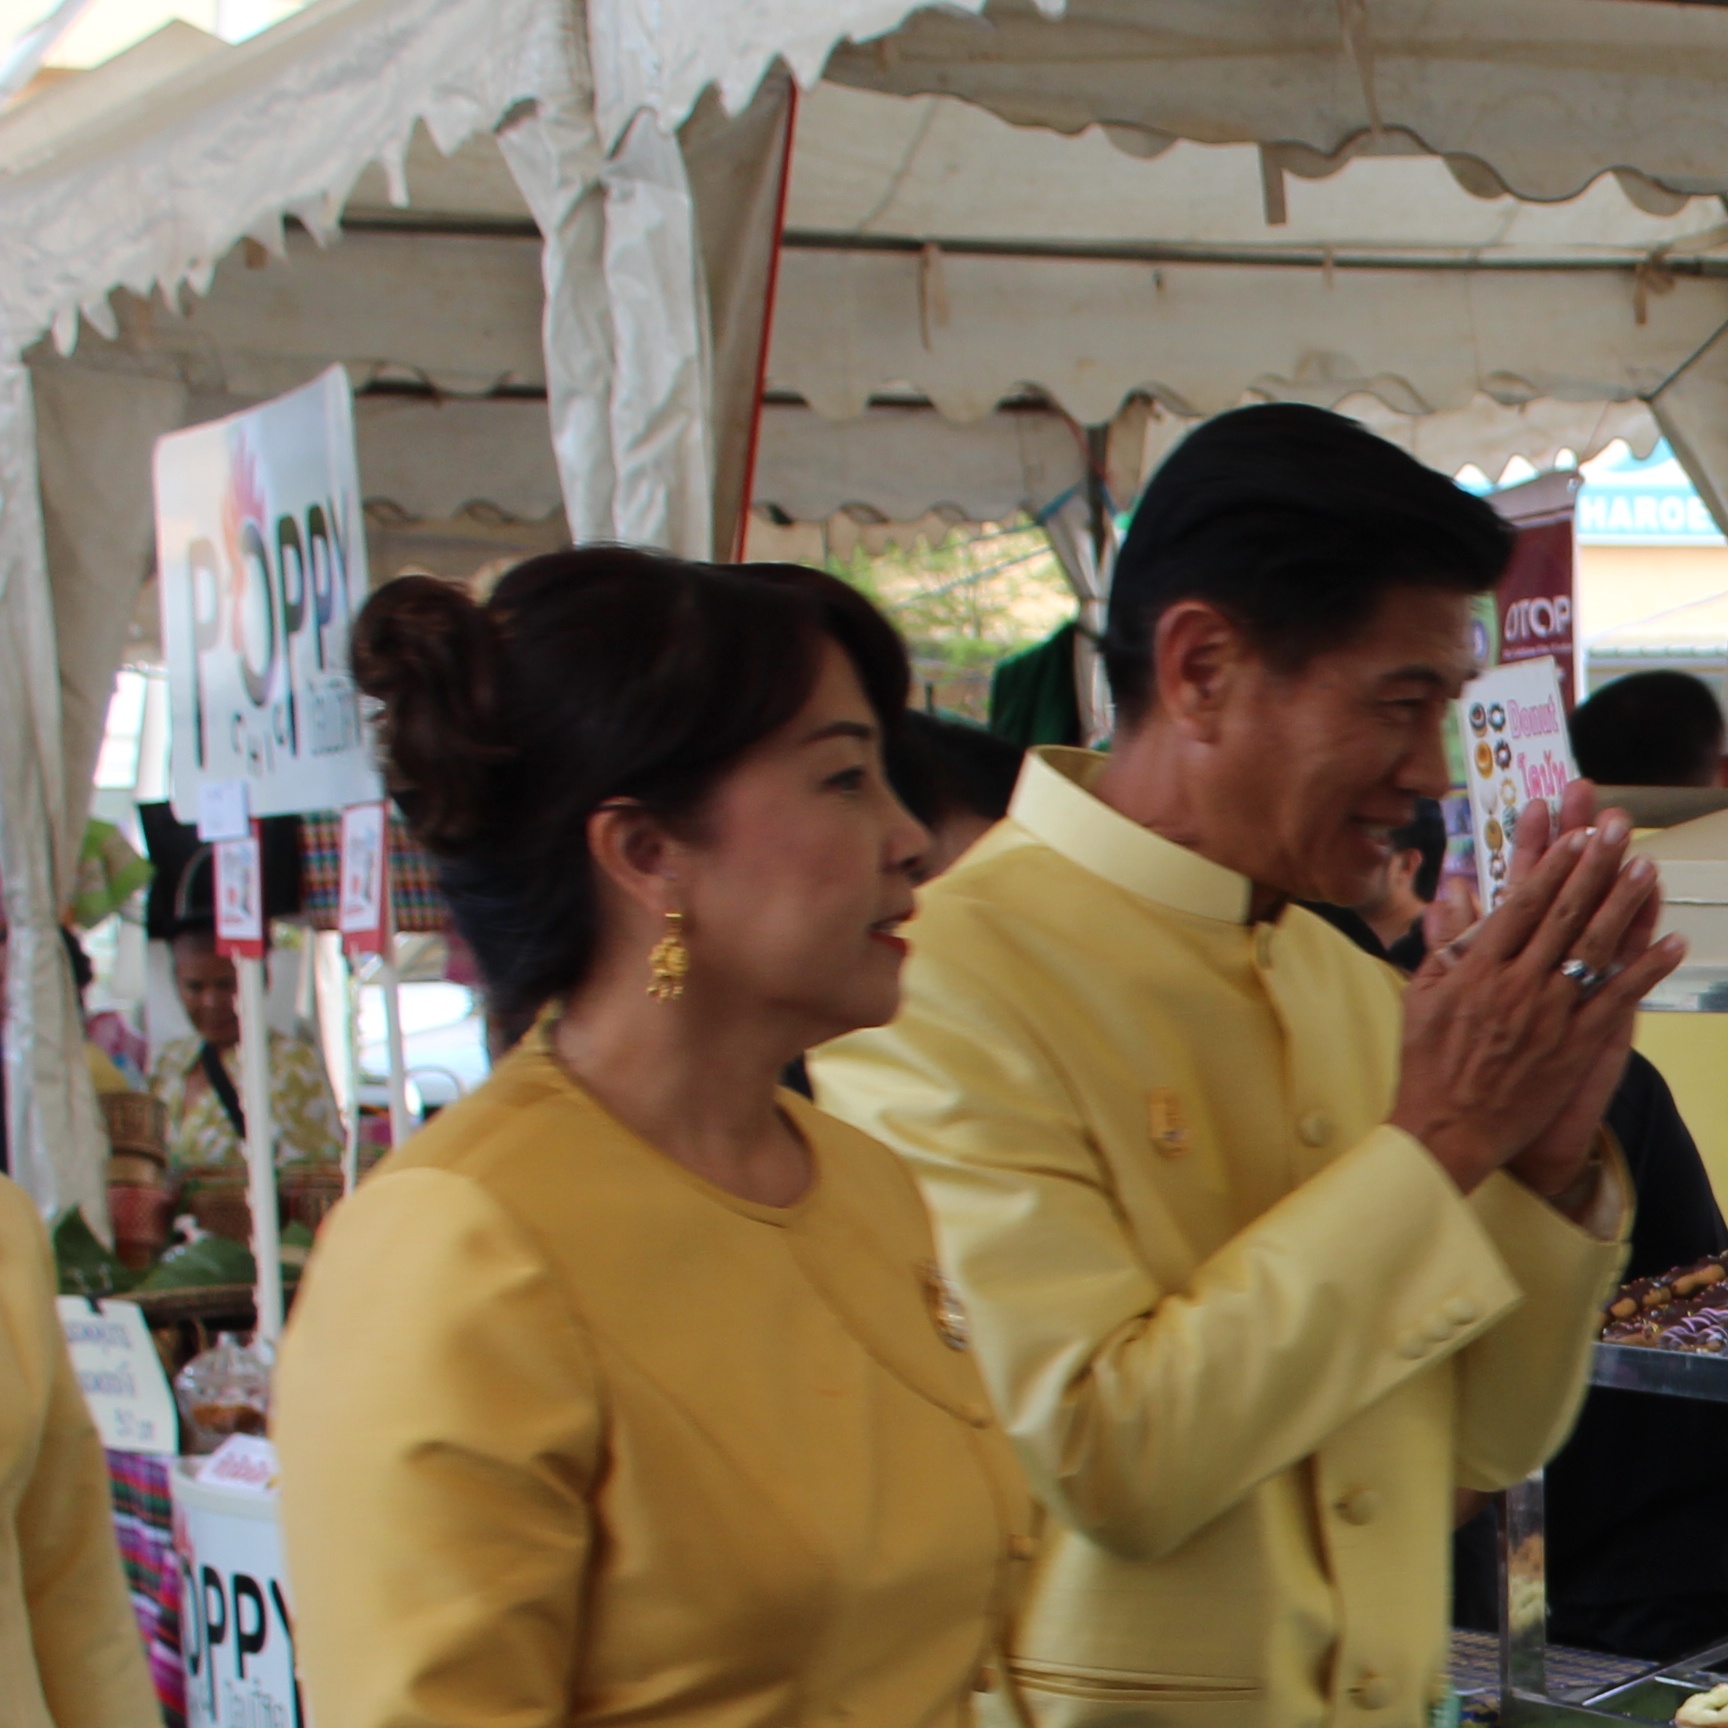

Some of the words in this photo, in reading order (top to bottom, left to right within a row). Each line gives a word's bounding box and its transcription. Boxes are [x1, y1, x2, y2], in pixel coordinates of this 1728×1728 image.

[187, 489, 353, 769] POPPY
[1504, 595, 1571, 641] OTOP
[1506, 695, 1559, 739] Donut
